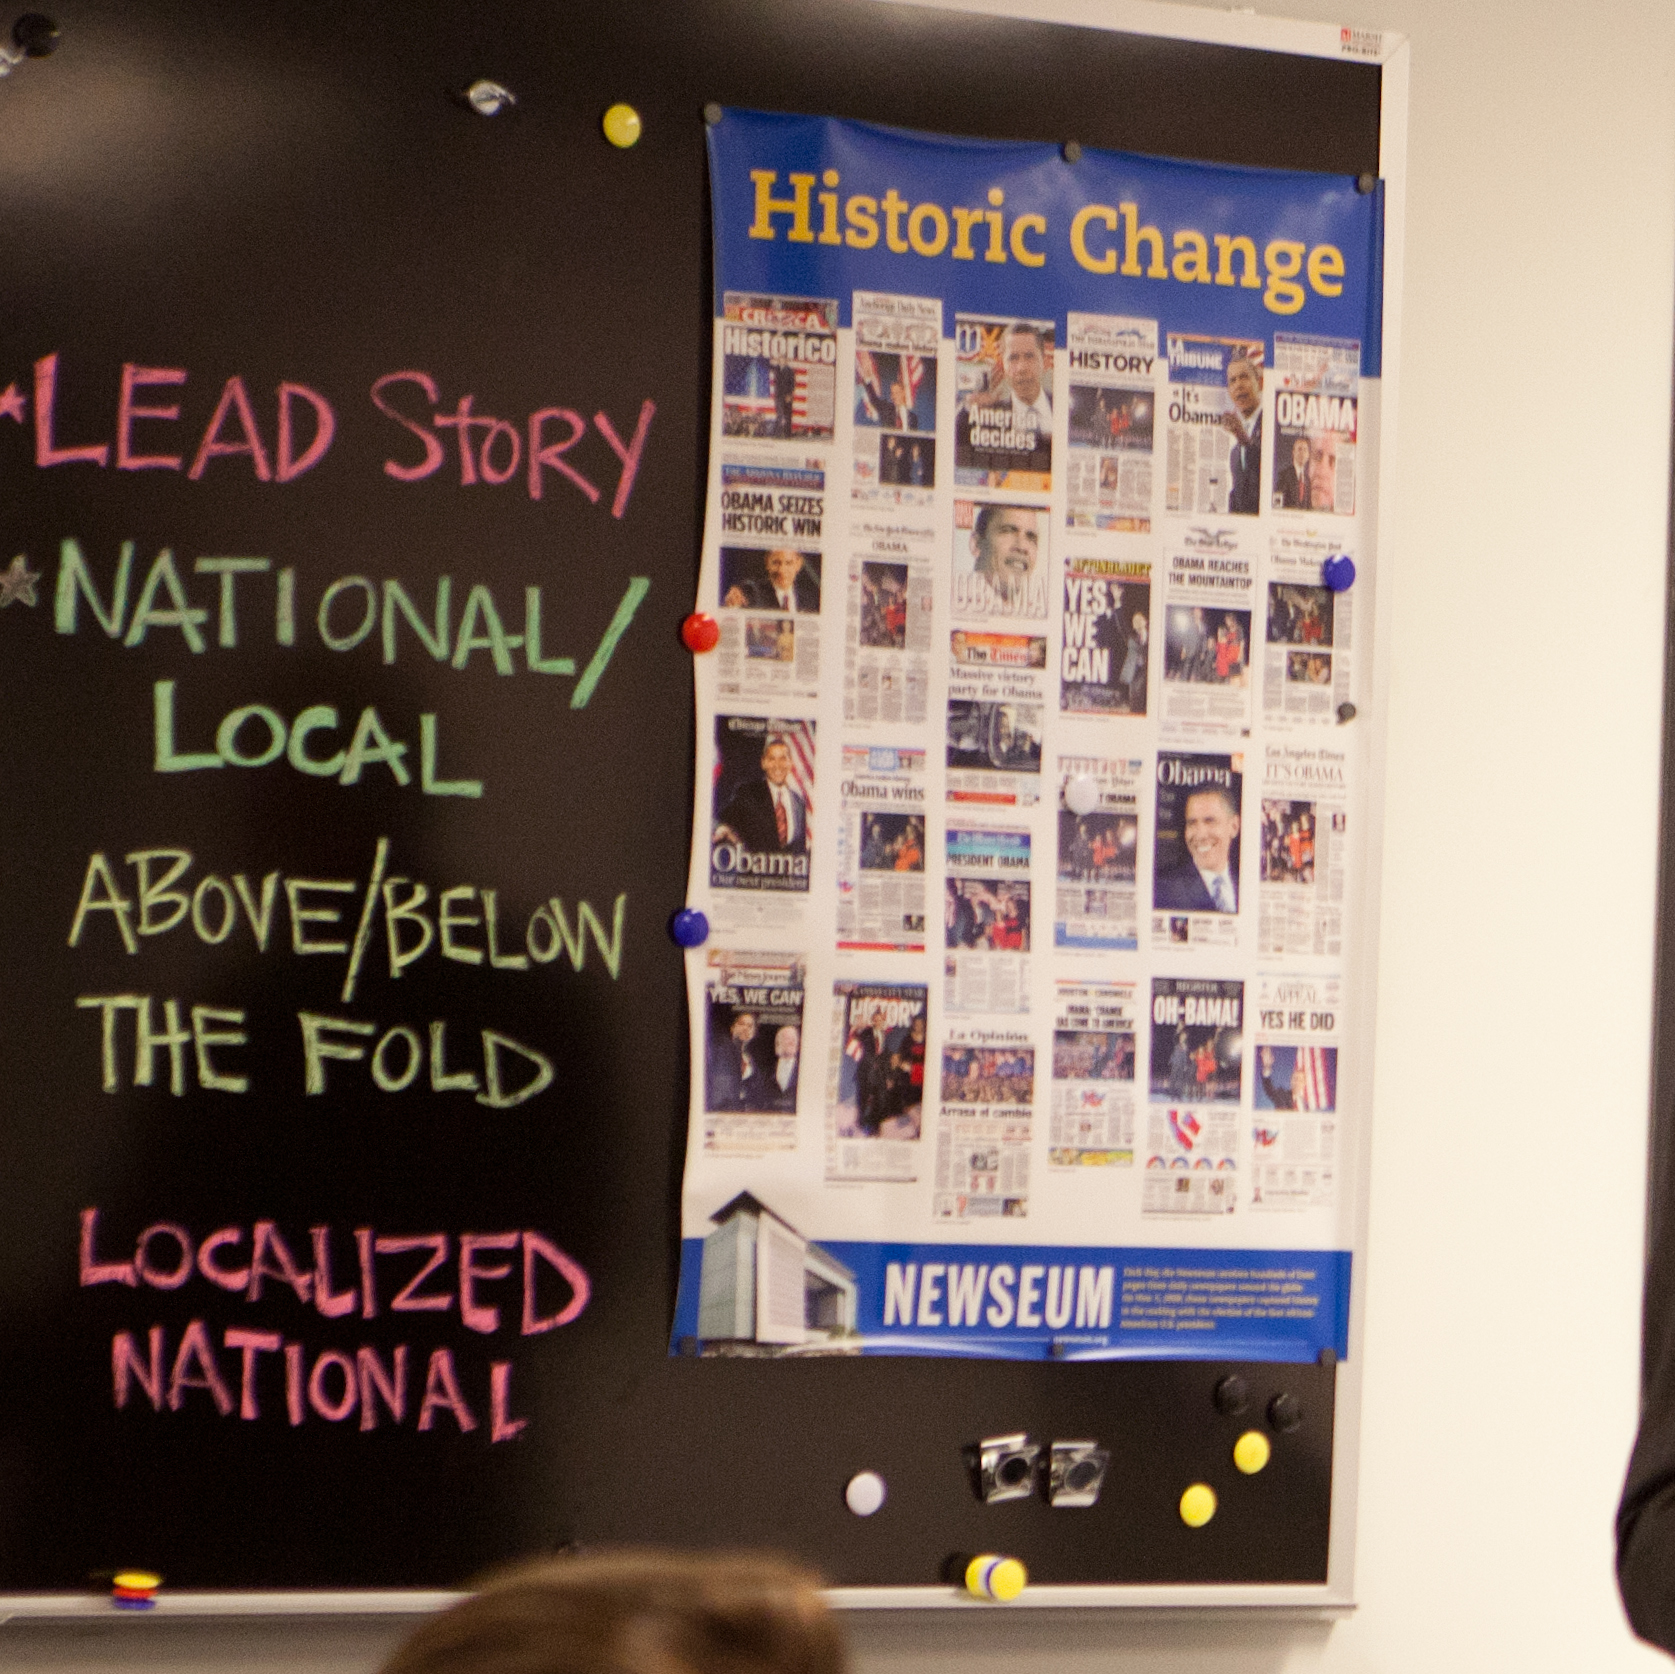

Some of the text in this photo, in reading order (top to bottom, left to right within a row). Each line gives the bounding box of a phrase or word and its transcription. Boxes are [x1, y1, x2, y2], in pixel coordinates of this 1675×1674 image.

[749, 168, 1346, 316] Historic Change
[1069, 351, 1155, 374] HISTORY
[34, 353, 336, 482] LEAD
[968, 403, 1038, 430] America
[1168, 402, 1222, 426] Obama
[1276, 392, 1356, 432] OBAMA
[970, 427, 1036, 451] decides
[721, 490, 824, 517] OBAMA SEIZES
[721, 512, 822, 538] HISTORIC WIN
[1172, 555, 1250, 574] OBAMA REACHES
[1169, 572, 1253, 590] THE MOUNTAINTOP
[1064, 577, 1113, 620] YES,
[1063, 612, 1098, 649] WE
[966, 646, 987, 660] The
[1061, 646, 1111, 685] CAN
[951, 666, 994, 681] Massive
[982, 682, 998, 696] for
[1002, 684, 1043, 700] Obama
[154, 680, 484, 798] LOCAL
[1157, 759, 1233, 788] Obama
[1294, 764, 1344, 782] OBAMA
[841, 780, 924, 801] Obama wins
[712, 843, 809, 877] Obama
[945, 853, 1030, 869] PRESIDENT OBAMA
[744, 988, 767, 1004] WE
[1153, 994, 1240, 1028] OH-BAMA!
[1259, 1010, 1335, 1032] YES HE DID
[76, 995, 555, 1109] THE FOLD
[79, 1207, 593, 1336] LOCALIZED
[882, 1261, 1115, 1330] NEWSEUM
[111, 1320, 528, 1444] NATIONAL
